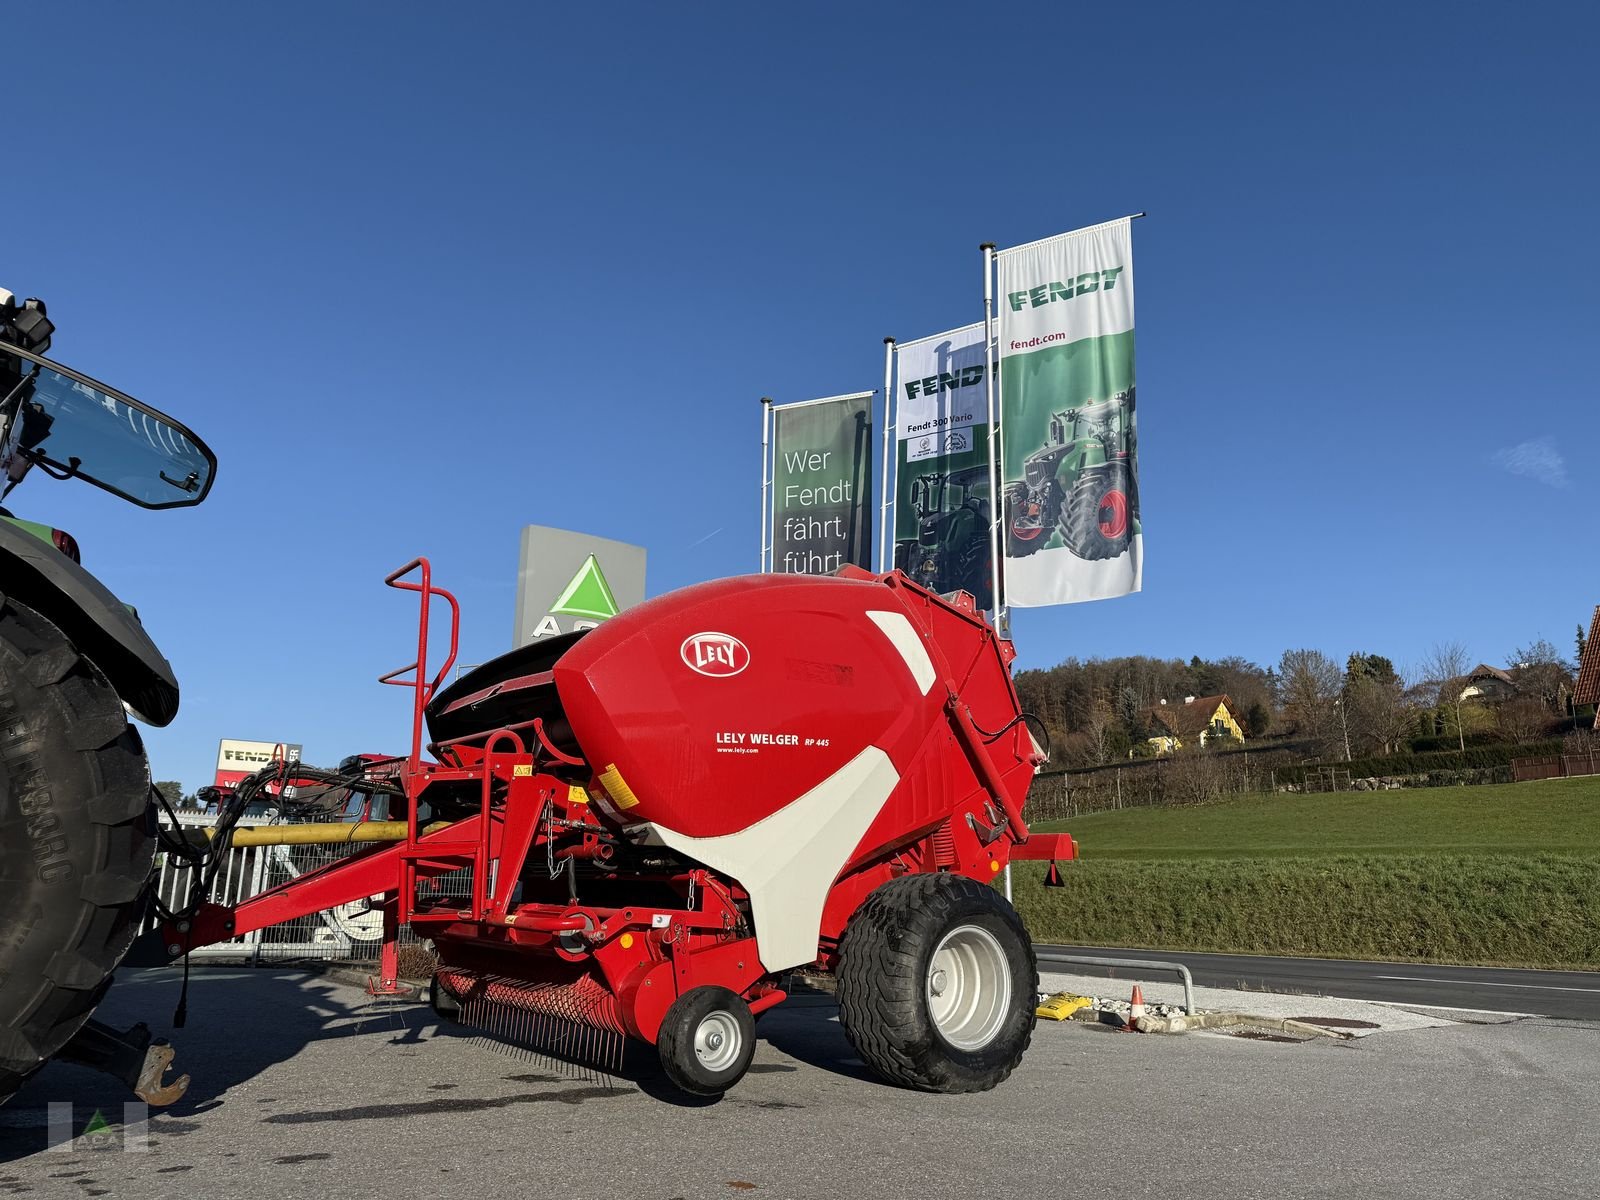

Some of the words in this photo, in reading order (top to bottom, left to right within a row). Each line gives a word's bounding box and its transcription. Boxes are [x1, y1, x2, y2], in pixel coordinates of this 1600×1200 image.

[1008, 265, 1124, 312] FENDT
[1010, 332, 1066, 350] fendt.com
[907, 421, 931, 433] Fendt
[932, 417, 949, 428] 300
[949, 413, 973, 423] Vario
[784, 450, 831, 474] Wer
[785, 479, 852, 508] Fendt
[784, 516, 847, 541] fährt,
[693, 639, 735, 668] LELY
[716, 732, 746, 744] LELY
[750, 733, 799, 746] WELGER
[804, 738, 815, 746] RP
[816, 738, 830, 747] 445
[717, 747, 759, 755] www.lely.com
